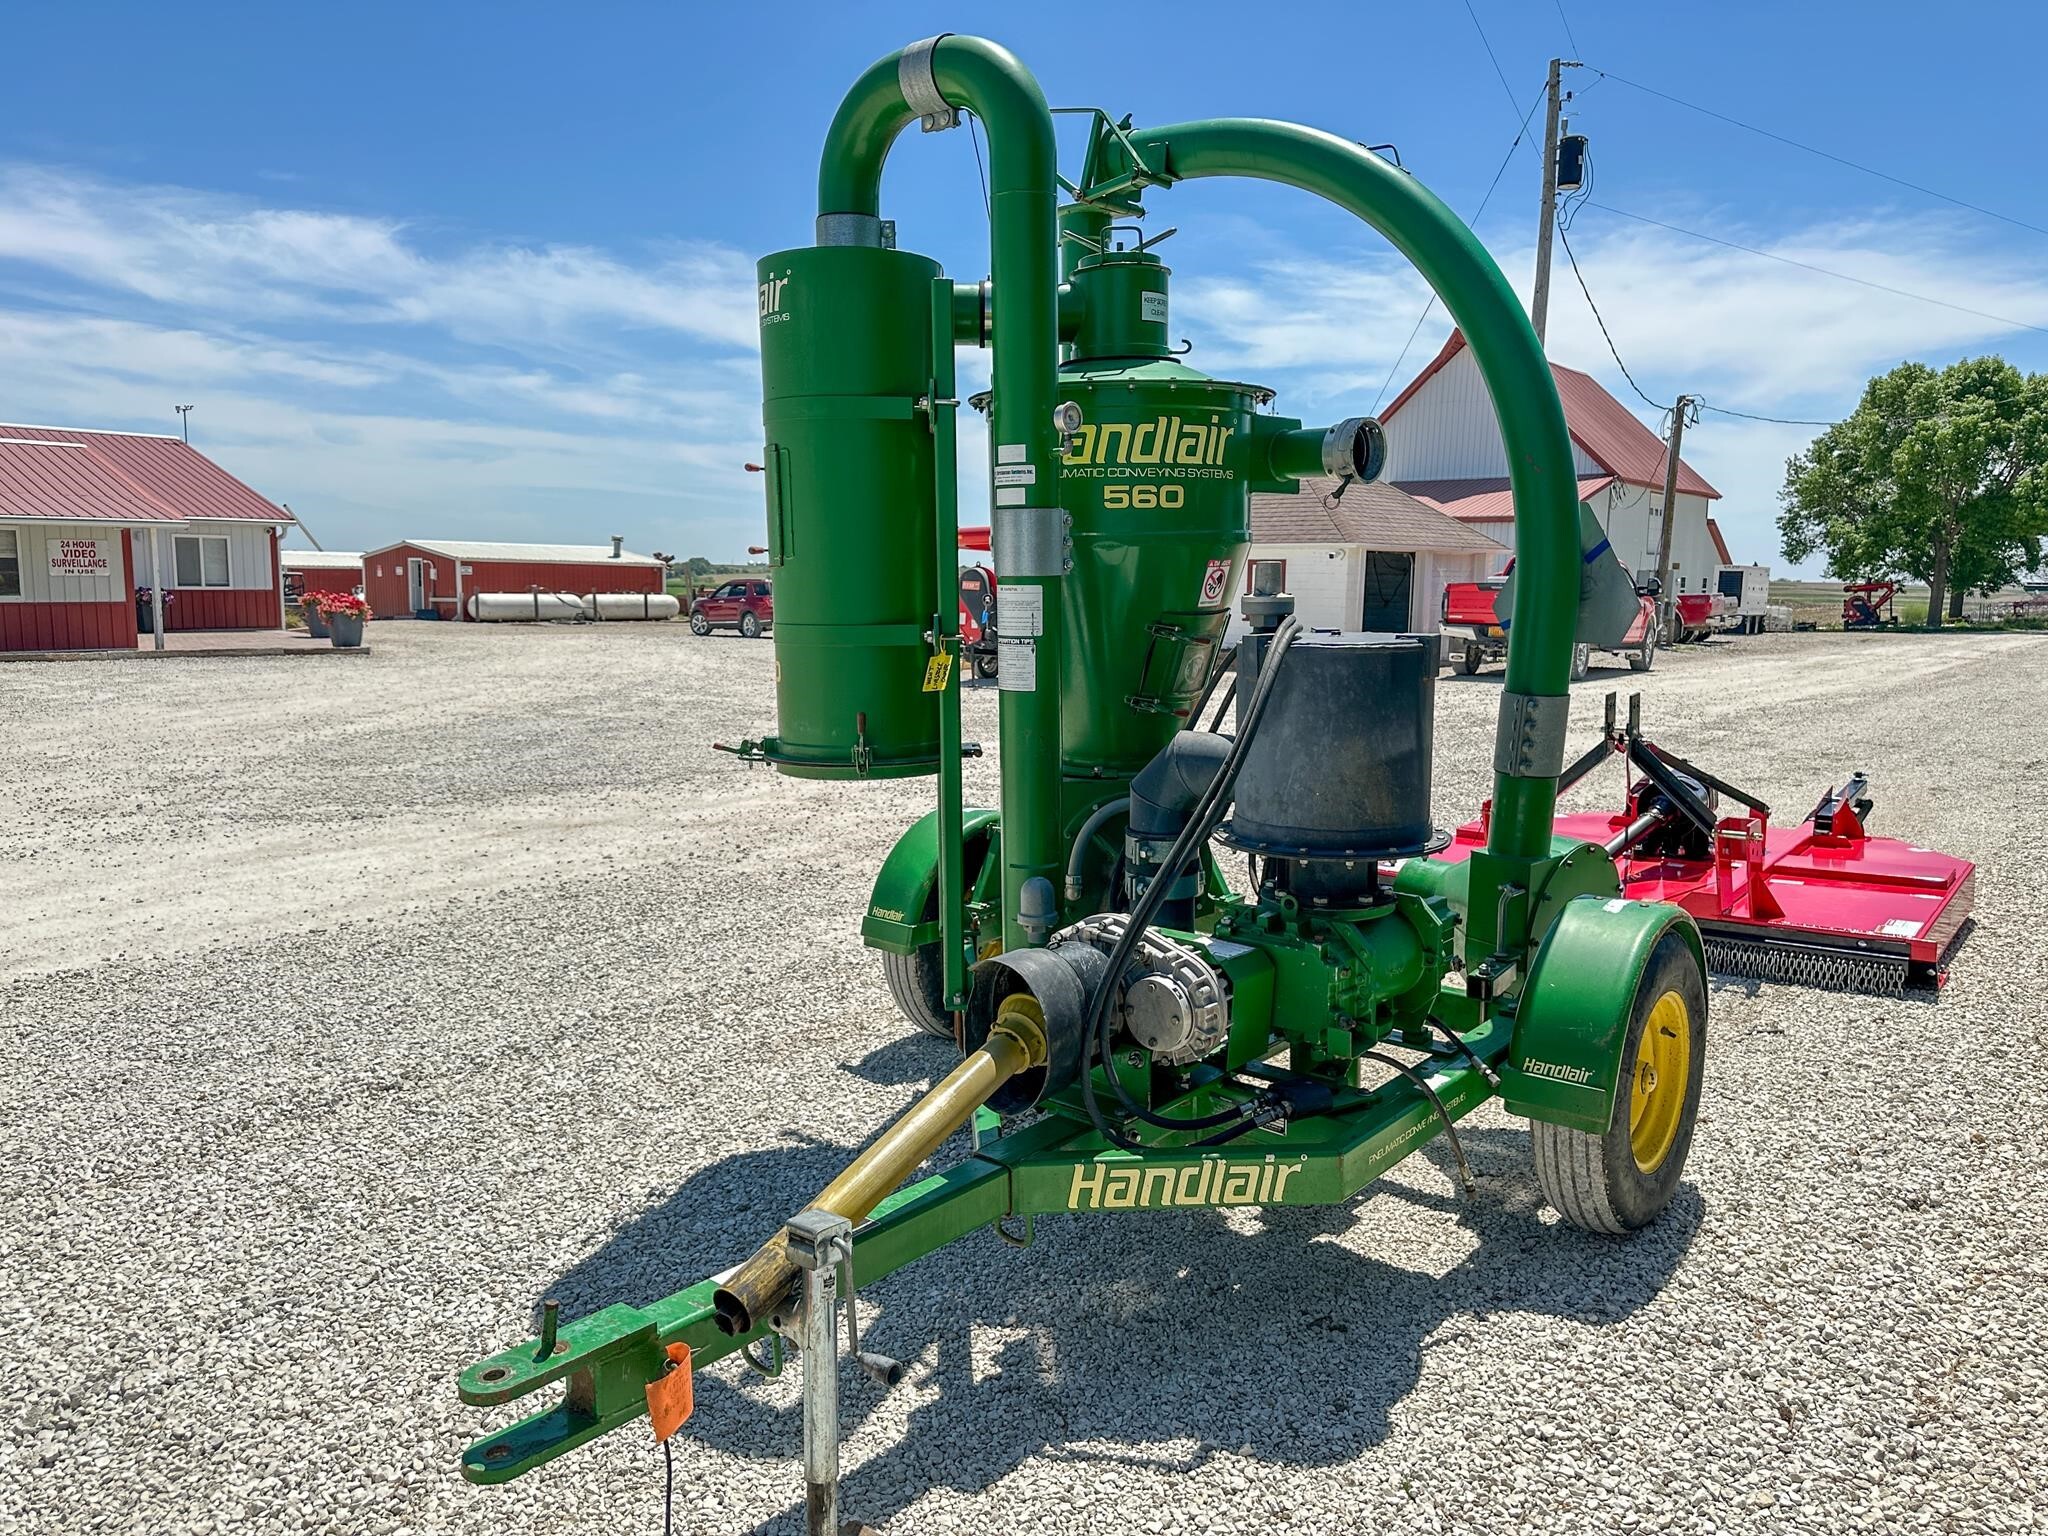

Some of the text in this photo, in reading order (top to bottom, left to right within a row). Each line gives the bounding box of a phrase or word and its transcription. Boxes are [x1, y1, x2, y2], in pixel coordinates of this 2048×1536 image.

[1061, 415, 1235, 465] andlair
[1107, 467, 1186, 478] CONVEYING
[1187, 468, 1234, 480] SYSTEMS
[1103, 485, 1185, 509] 560
[51, 558, 107, 568] SURVEILLANCE
[61, 549, 97, 558] VIDEO
[872, 906, 905, 921] Handlair
[1522, 1057, 1594, 1083] Handlair
[1368, 1134, 1406, 1165] PNEUMATIC
[1067, 1154, 1304, 1208] Handlair
